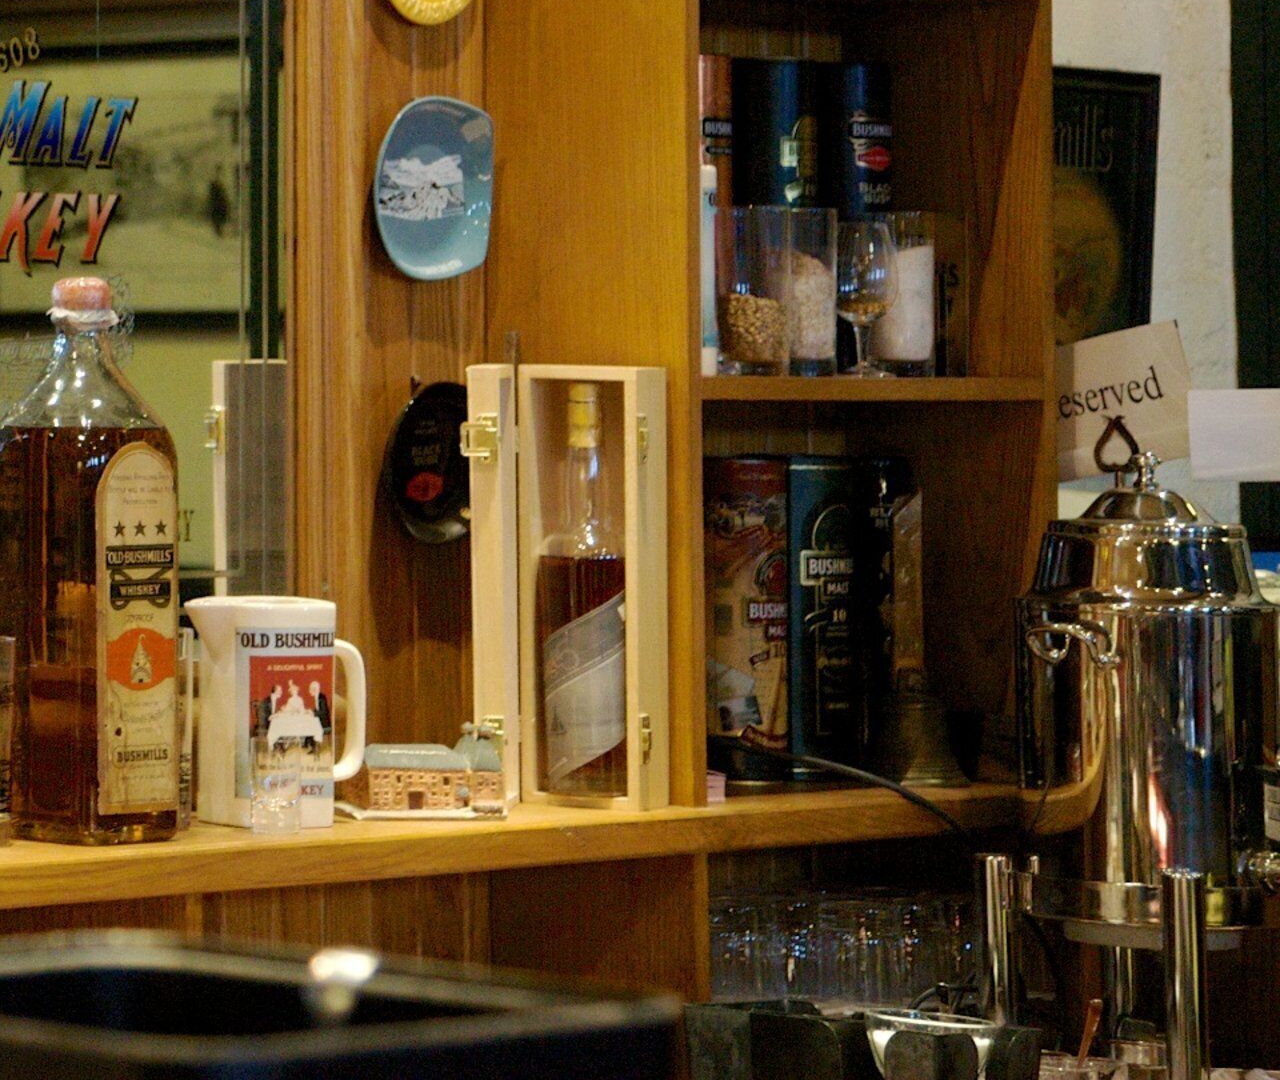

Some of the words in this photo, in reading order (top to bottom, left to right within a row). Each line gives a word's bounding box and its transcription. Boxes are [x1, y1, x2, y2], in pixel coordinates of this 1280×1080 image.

[119, 582, 162, 597] WHISKEY
[272, 663, 305, 672] DELIGHTFUL
[306, 662, 324, 671] SPIRIT
[115, 747, 169, 764] BUSHMILLS
